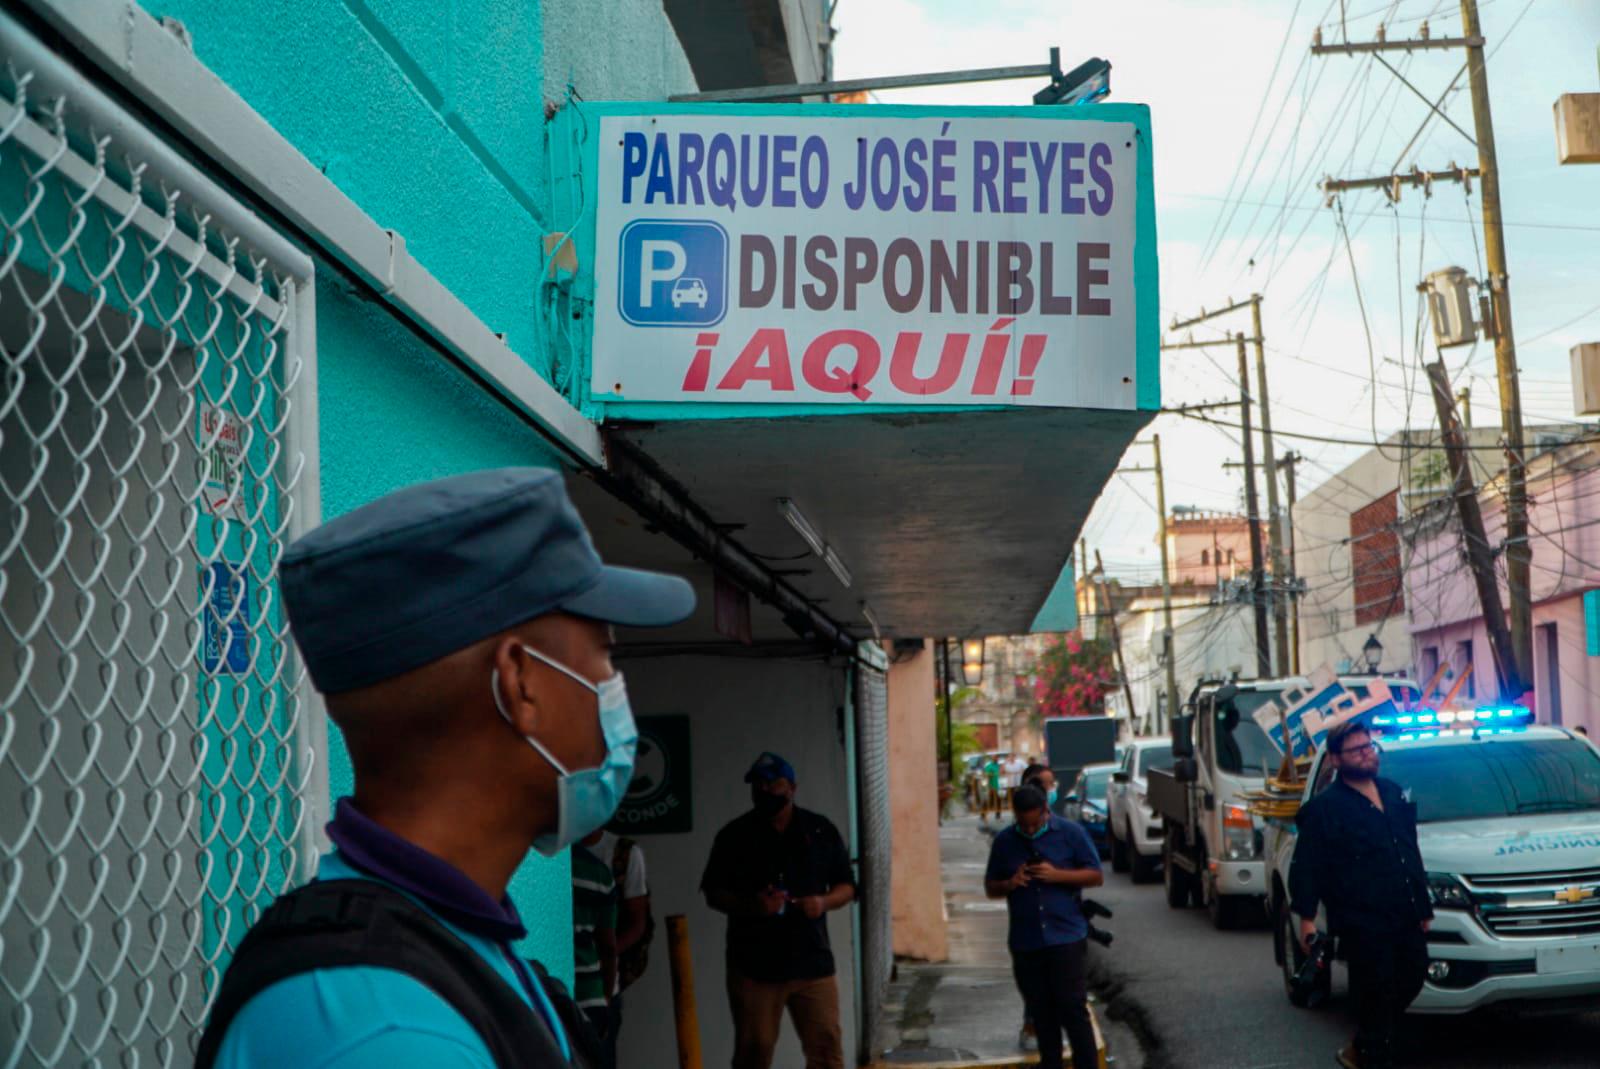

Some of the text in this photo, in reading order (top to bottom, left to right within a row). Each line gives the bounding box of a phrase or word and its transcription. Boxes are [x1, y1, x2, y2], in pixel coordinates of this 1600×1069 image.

[622, 121, 1114, 216] PARQUEO JOSÉ REYES
[638, 239, 687, 308] P
[738, 234, 1111, 316] DISPONIBLE
[681, 317, 1048, 401] ¡AQUÍ!
